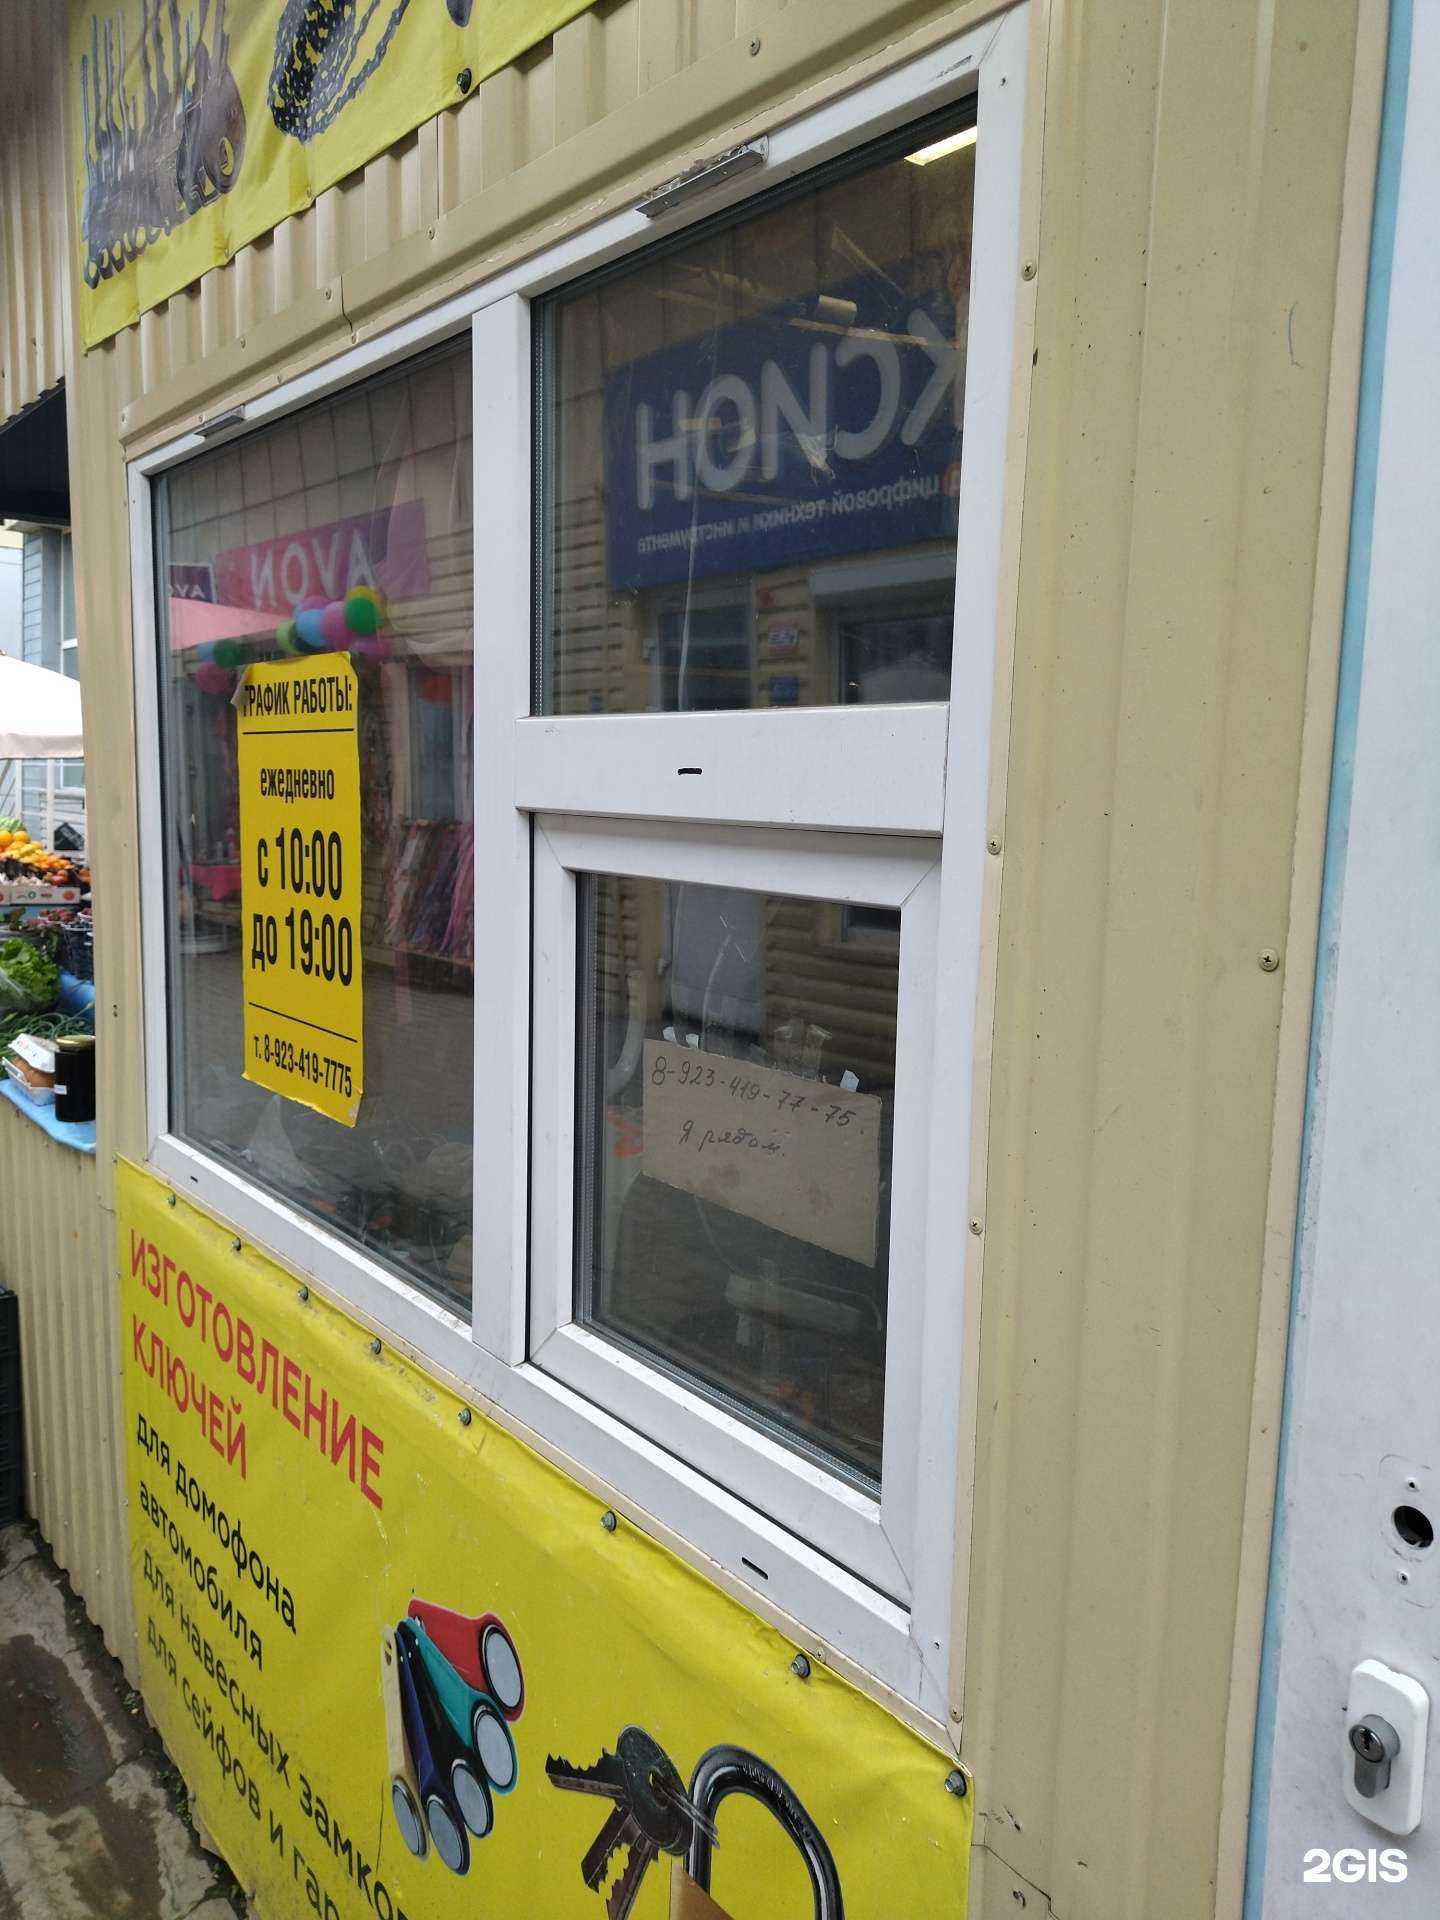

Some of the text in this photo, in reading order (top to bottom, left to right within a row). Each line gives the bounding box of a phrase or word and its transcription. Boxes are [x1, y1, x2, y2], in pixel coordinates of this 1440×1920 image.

[294, 675, 352, 714] РАБОТЫ:
[260, 767, 335, 803] ежедневно
[276, 827, 342, 900] 10:00
[252, 907, 353, 986] до 19:00
[264, 1034, 352, 1098] 8-923-419-7775
[679, 1119, 694, 1145] Я
[131, 1228, 383, 1511] ИЗГОТОВЛЕНИЕ
[132, 1312, 247, 1480] КЛЮЧЕЙ
[137, 1413, 297, 1635] для домофона
[140, 1480, 263, 1671] автомобиля
[144, 1550, 407, 1920] для навесных замко
[149, 1616, 177, 1688] для
[182, 1677, 261, 1821] сейфов
[269, 1809, 284, 1858] и
